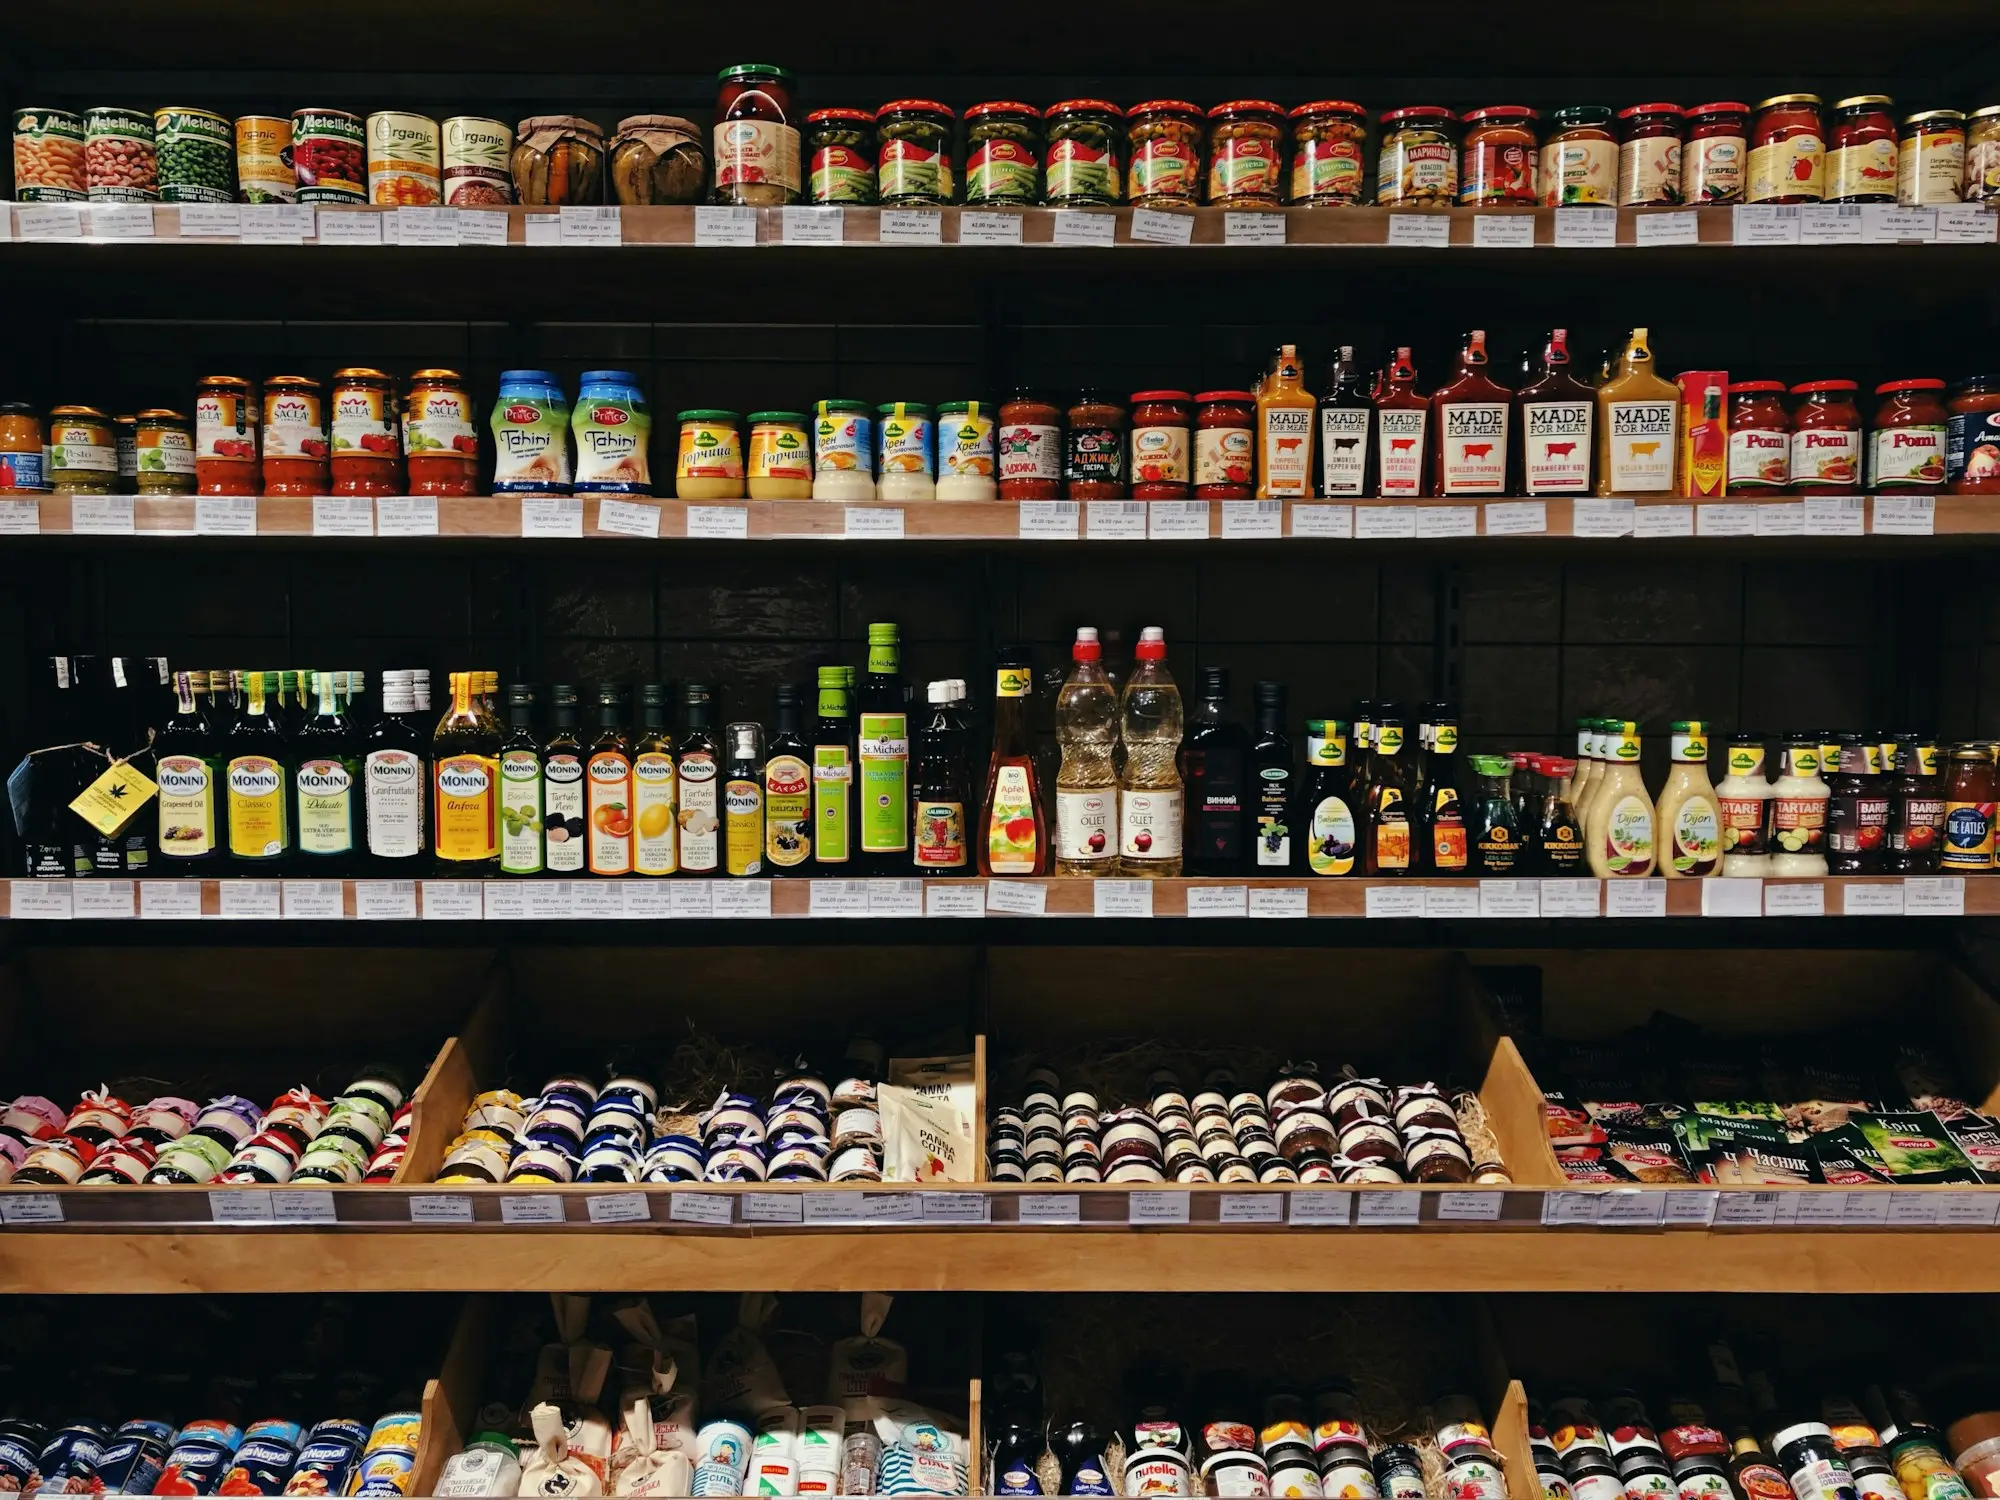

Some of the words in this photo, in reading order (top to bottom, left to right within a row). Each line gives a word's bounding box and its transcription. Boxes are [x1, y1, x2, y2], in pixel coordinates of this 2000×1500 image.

[376, 117, 433, 144] Organic
[449, 122, 505, 150] Organic
[1409, 145, 1451, 161] МАРИНАДО
[505, 409, 540, 422] Prince
[591, 410, 628, 423] Prince
[1269, 414, 1308, 425] MADE
[1326, 413, 1365, 424] MADE
[1383, 414, 1422, 425] MADE
[1448, 410, 1503, 425] MADE
[1530, 408, 1587, 424] MADE
[1614, 408, 1670, 423] MADE
[1286, 424, 1308, 432] MEAT
[1383, 424, 1398, 432] FOR
[1399, 424, 1422, 432] MEAT
[1448, 425, 1470, 434] FOR
[1472, 425, 1504, 434] MEAT
[1529, 424, 1552, 433] FOR
[1554, 423, 1588, 433] MEAT
[1614, 425, 1638, 434] FOR
[1640, 424, 1672, 433] MEAT
[500, 430, 550, 451] Tahini
[585, 431, 637, 452] Tahini
[818, 437, 837, 450] Хрен
[884, 439, 906, 451] Хрен
[955, 440, 981, 453] Хрен
[66, 448, 92, 460] Pesto
[164, 452, 189, 464] Pesto
[682, 446, 732, 469] Горчица
[1074, 453, 1115, 465] АДЖИКА
[1005, 462, 1037, 475] АДЖИКА
[1083, 463, 1105, 473] ГОСТРА
[1326, 463, 1349, 471] PEPPER
[1449, 466, 1474, 474] GRILLED
[1475, 466, 1502, 474] PAPRIKA
[1531, 465, 1570, 473] CRANBERRY
[1572, 464, 1586, 472] BBQ
[16, 474, 40, 483] PESTO
[513, 483, 535, 491] Natural
[863, 744, 873, 754] St.
[874, 743, 905, 755] Michele
[373, 765, 412, 777] MONINI
[504, 763, 538, 774] MONINI
[547, 765, 581, 775] MONINI
[591, 765, 626, 775] MONINI
[639, 765, 673, 776] MONINI
[681, 764, 715, 775] MONINI
[160, 774, 204, 787] MONINI
[231, 774, 277, 787] MONINI
[298, 774, 348, 787] MONINI
[441, 774, 487, 788] MONINI
[1008, 771, 1020, 780] BIO
[371, 785, 416, 797] GranFruttato
[683, 788, 713, 799] Tartufo
[1001, 784, 1025, 796] Apfel
[506, 791, 535, 802] Basilico
[551, 792, 579, 803] Tartufo
[685, 797, 712, 808] Bianco
[1206, 795, 1237, 805] ВИННИЙ
[1261, 795, 1287, 804] Balsamic
[162, 800, 194, 811] Grapeseed
[194, 800, 205, 809] Oil
[237, 799, 273, 809] Classico
[305, 798, 343, 811] Delicato
[555, 801, 574, 811] Nero
[770, 805, 804, 814] DELICATE
[1777, 801, 1826, 814] TARTARE
[1080, 815, 1106, 827] ОЦЕТ
[1129, 815, 1154, 826] ОЦЕТ
[1317, 814, 1350, 824] Balsamic
[1616, 812, 1646, 826] Dijon
[1682, 812, 1712, 826] Dijon
[1777, 813, 1798, 822] SAUCE
[1860, 812, 1882, 822] SAUCE
[1910, 812, 1934, 822] SAUCE
[1948, 821, 1959, 834] THE
[1960, 820, 1986, 836] EATLES
[39, 844, 62, 854] Zorya
[1876, 1118, 1923, 1134] Кріп
[920, 1128, 956, 1157] PANNA
[1607, 1140, 1672, 1154] Коріандр
[921, 1139, 955, 1165] COTTA
[1745, 1146, 1812, 1174] Часник
[177, 1452, 217, 1465] Napoli
[253, 1447, 291, 1461] Napoli
[312, 1446, 346, 1460] Napoli
[918, 1456, 950, 1470] СІЛЬ
[1135, 1463, 1177, 1480] nutella
[709, 1474, 733, 1487] СІЛЬ
[451, 1485, 476, 1495] СІЛЬ
